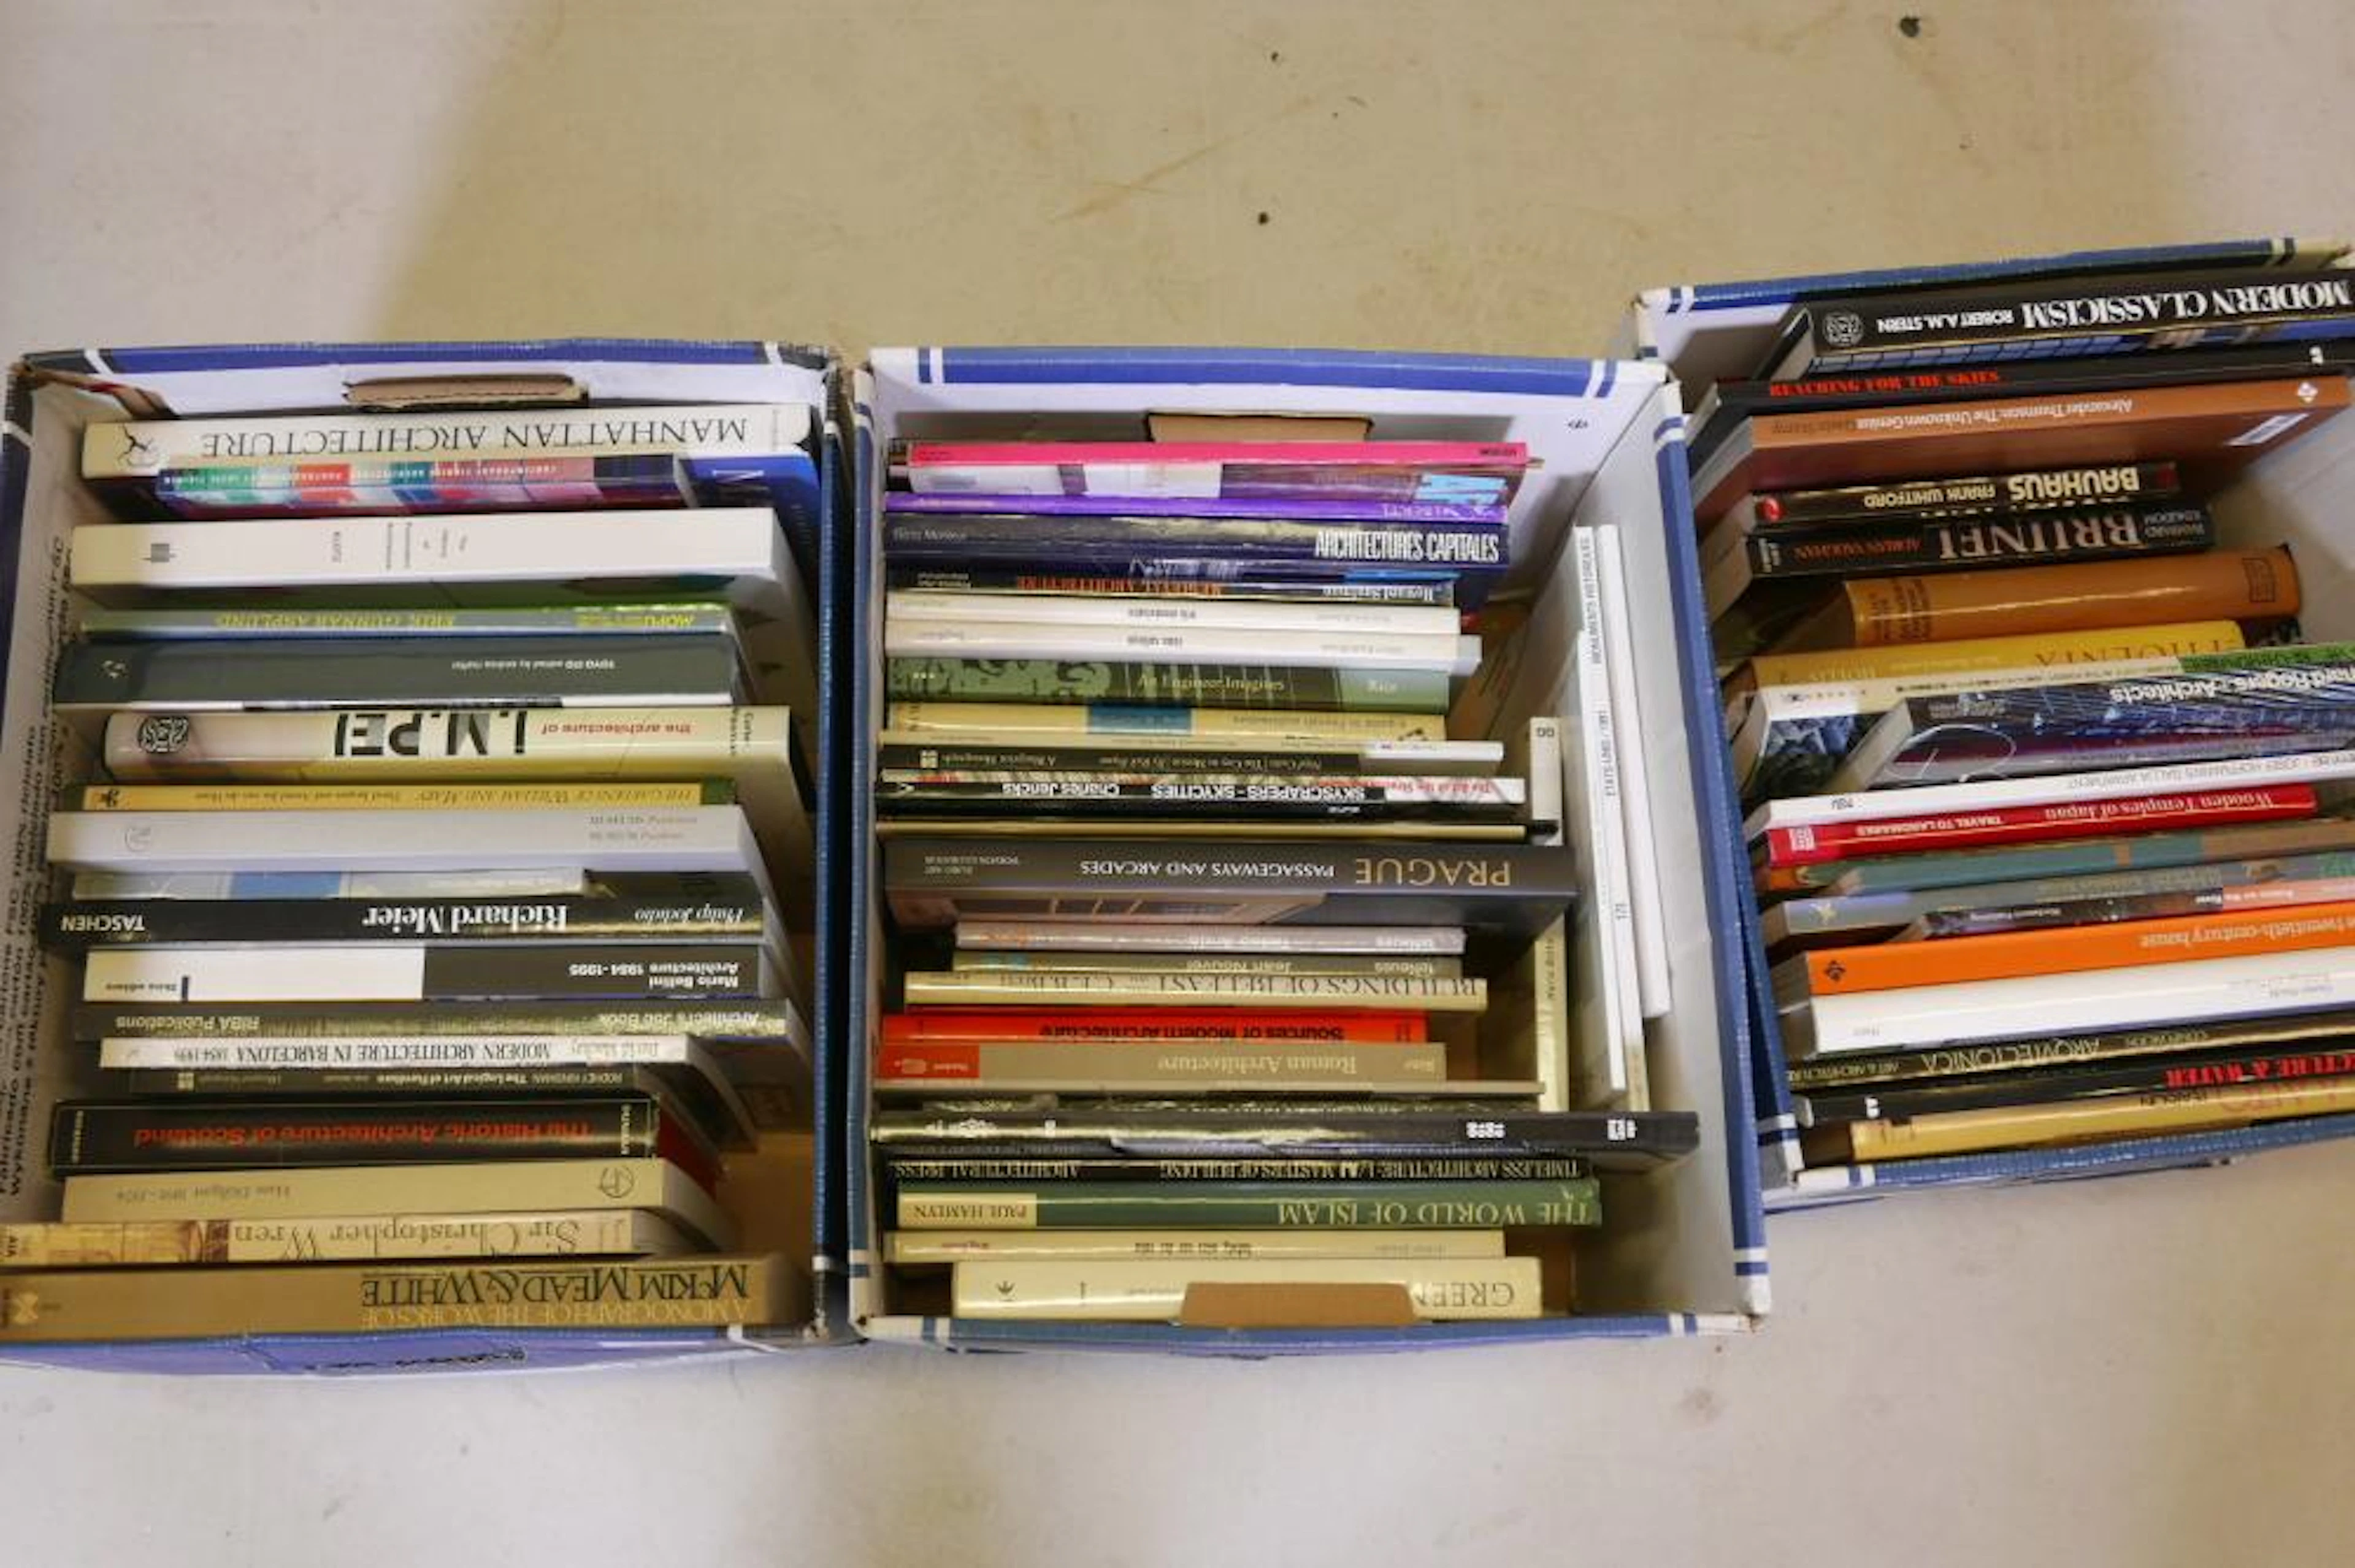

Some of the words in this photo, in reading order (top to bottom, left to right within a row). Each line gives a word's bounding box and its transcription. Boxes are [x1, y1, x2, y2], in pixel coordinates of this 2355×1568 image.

[2211, 278, 2353, 318] MODERN
[1959, 309, 2015, 328] ROBERT
[2022, 291, 2208, 329] CLASSICISM
[1877, 316, 1923, 335] STERN
[1770, 379, 1861, 397] REACHING
[1864, 376, 1902, 391] FOR
[1907, 375, 1942, 389] THE
[1947, 369, 1999, 386] SKIES
[1973, 410, 1999, 423] The
[2069, 399, 2134, 418] Alexander
[1855, 416, 1902, 430] Genius
[1905, 411, 1972, 427] Unknown
[201, 426, 488, 459] ARCHITECTURE
[504, 418, 748, 449] MANHATTAN
[1946, 483, 1996, 502] FRANK
[2007, 467, 2140, 502] BAUHAUS
[1864, 488, 1944, 508] WHITFORD
[1315, 530, 1421, 562] ARCHITECTURES
[2109, 679, 2217, 704] Architects
[540, 724, 559, 738] of
[562, 723, 661, 737] architecture
[664, 724, 692, 737] the
[1060, 782, 1119, 797] Charles
[1151, 784, 1235, 798] SKYCITIES
[1247, 784, 1365, 800] SKYSCRAPERS
[2100, 803, 2118, 817] of
[2120, 795, 2196, 814] Temples
[2200, 792, 2274, 810] Wooden
[2045, 800, 2098, 822] Japan
[1856, 820, 1935, 838] LANDMARKS
[1937, 818, 1955, 830] TO
[1956, 814, 2002, 828] TRAVEL
[1079, 860, 1161, 875] ARCADES
[1166, 862, 1206, 876] AND
[1211, 863, 1335, 878] PASSAGEWAYS
[1355, 858, 1511, 886] PRAGUE
[61, 913, 145, 932] TASCHEN
[362, 906, 446, 935] Meier
[450, 904, 568, 935] Richard
[2140, 930, 2189, 949] house
[649, 963, 739, 976] Architecture
[1187, 958, 1248, 973] Nouvel
[1254, 961, 1291, 974] Jean
[648, 976, 694, 989] Bellini
[697, 976, 739, 989] Mario
[1286, 976, 1319, 993] OF
[1325, 976, 1476, 996] BUILDINGS
[115, 1016, 215, 1032] Publications
[217, 1015, 260, 1031] RIBA
[599, 1013, 640, 1028] Book
[644, 1012, 672, 1028] Job
[1241, 1028, 1262, 1041] of
[1265, 1027, 1344, 1041] Sources
[237, 1044, 329, 1062] BARCELONA
[334, 1044, 351, 1061] IN
[359, 1042, 477, 1061] ARCHITECTURE
[484, 1042, 551, 1060] MODERN
[506, 1073, 527, 1085] The
[134, 1128, 247, 1150] Scotland
[445, 1122, 540, 1143] Historic
[895, 1164, 943, 1179] PRESS
[1160, 1163, 1237, 1179] BUILDING
[1260, 1162, 1338, 1178] MASTERS
[1502, 1160, 1579, 1177] TIMELESS
[913, 1204, 982, 1219] HAMLYN
[990, 1204, 1027, 1218] PAUL
[1277, 1203, 1358, 1225] ISLAM
[1371, 1203, 1408, 1225] OF
[1417, 1203, 1526, 1226] WORLD
[1536, 1203, 1590, 1225] THE
[232, 1226, 321, 1262] Wren
[330, 1217, 521, 1259] Christopher
[529, 1222, 581, 1253] Sir
[361, 1271, 486, 1308] WHITE
[523, 1268, 629, 1303] MEAD
